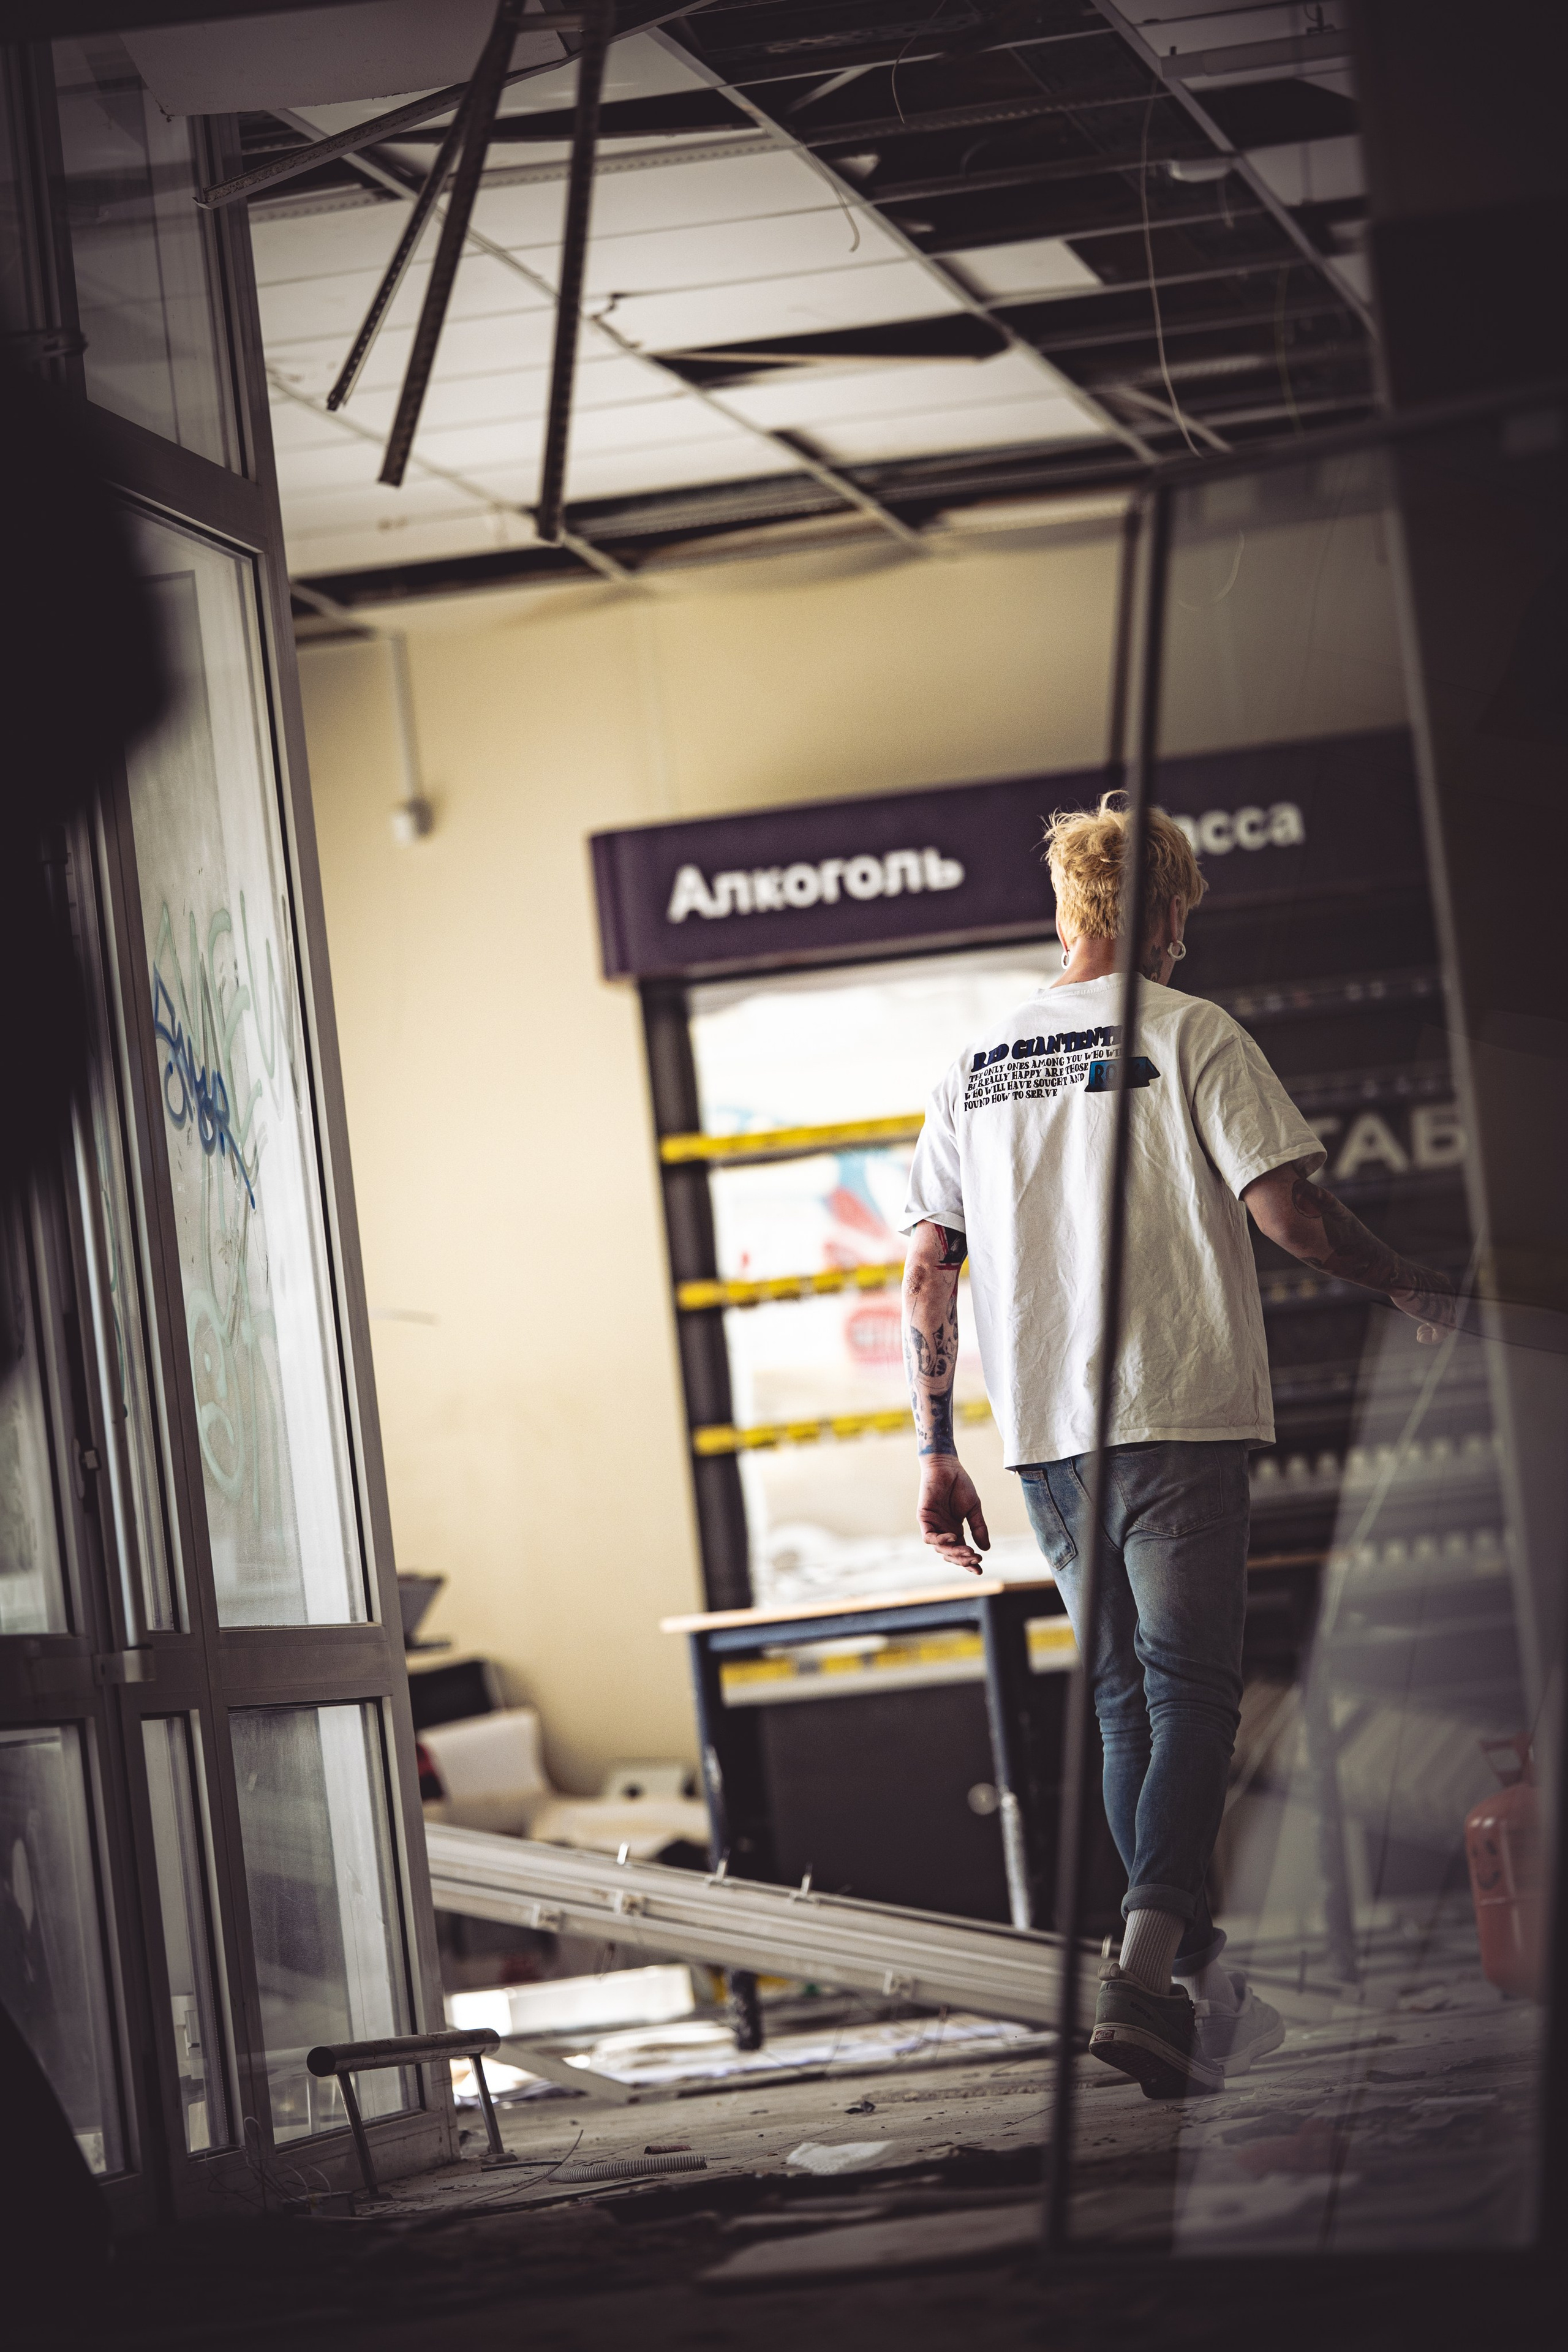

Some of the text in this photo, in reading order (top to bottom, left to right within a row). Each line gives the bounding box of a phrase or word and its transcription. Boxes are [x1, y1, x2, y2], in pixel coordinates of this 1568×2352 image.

[1170, 801, 1306, 856] асса
[667, 848, 963, 922] Алкоголь
[978, 1072, 1011, 1088] REALLY
[1012, 1069, 1042, 1080] HAPPY
[1044, 1068, 1064, 1077] ARE
[1065, 1062, 1088, 1074] THOSE
[984, 1065, 1005, 1076] ONLY
[1007, 1061, 1030, 1071] ONES
[1031, 1057, 1065, 1069] AMONG
[1066, 1054, 1082, 1065] YOU
[1085, 1050, 1104, 1061] WHO
[964, 1088, 1058, 1112] FOUND HOW TO SERVE
[965, 1073, 1085, 1101] WHO WILL HAVE SOUGHT AND
